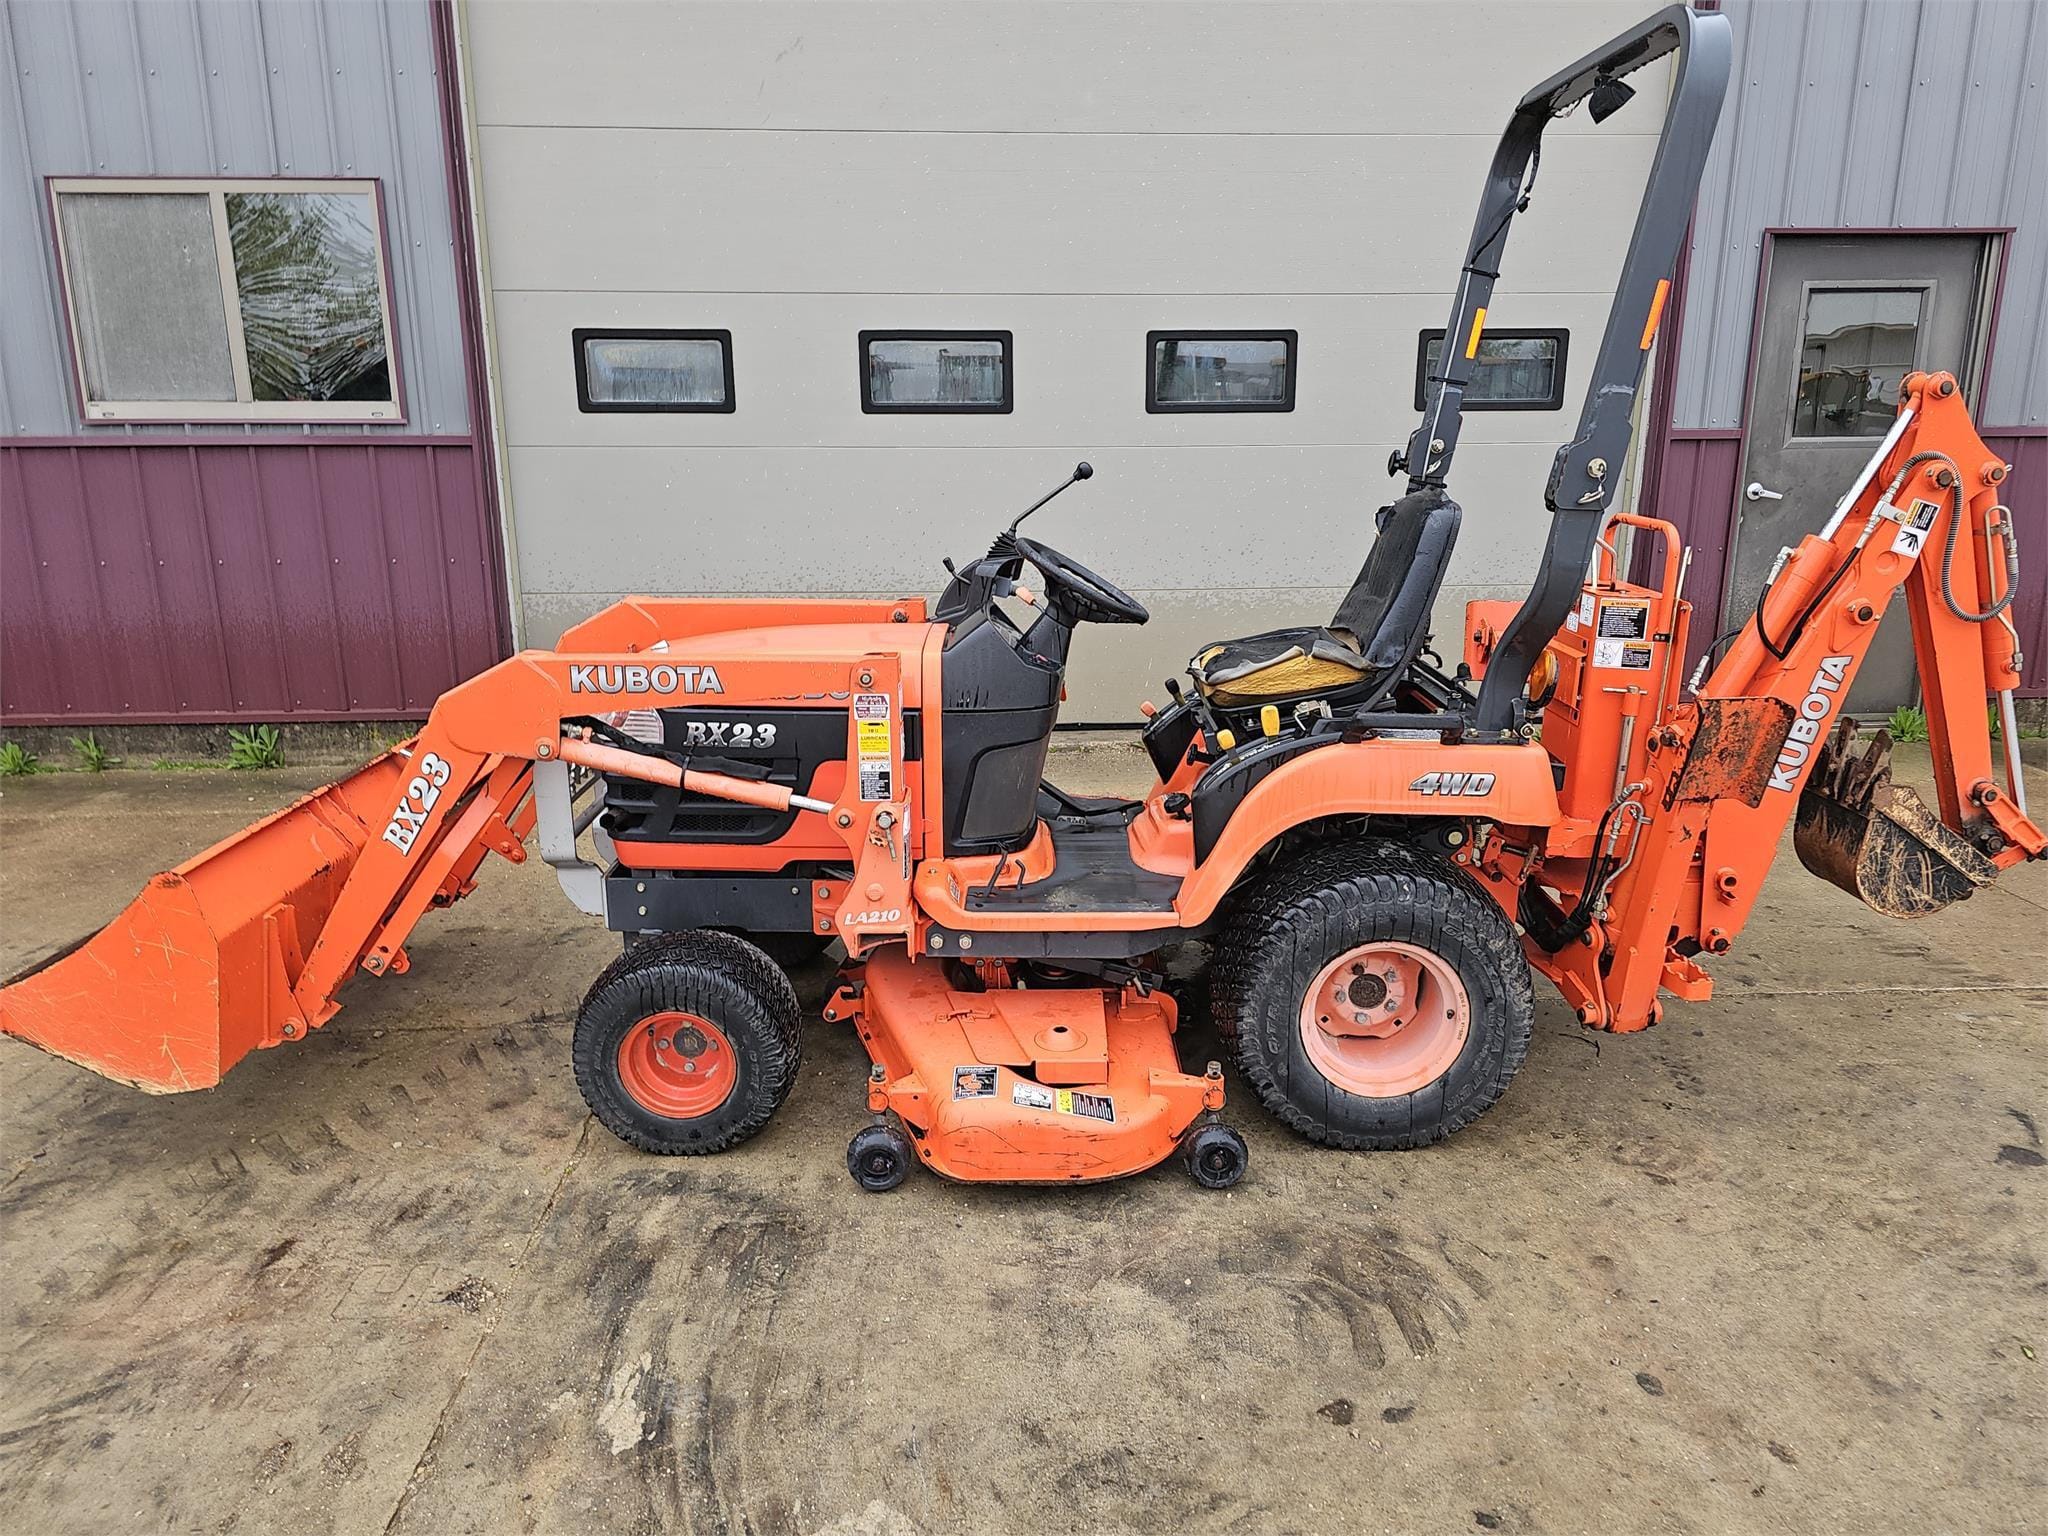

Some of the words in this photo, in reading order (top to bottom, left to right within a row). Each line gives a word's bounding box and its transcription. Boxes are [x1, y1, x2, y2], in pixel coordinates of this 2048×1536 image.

[569, 664, 725, 695] KUBOTA
[683, 721, 777, 748] BX23
[1767, 655, 1853, 793] KUBOTA
[1408, 771, 1496, 797] 4WD
[382, 752, 451, 857] BX23
[844, 908, 901, 926] LA210
